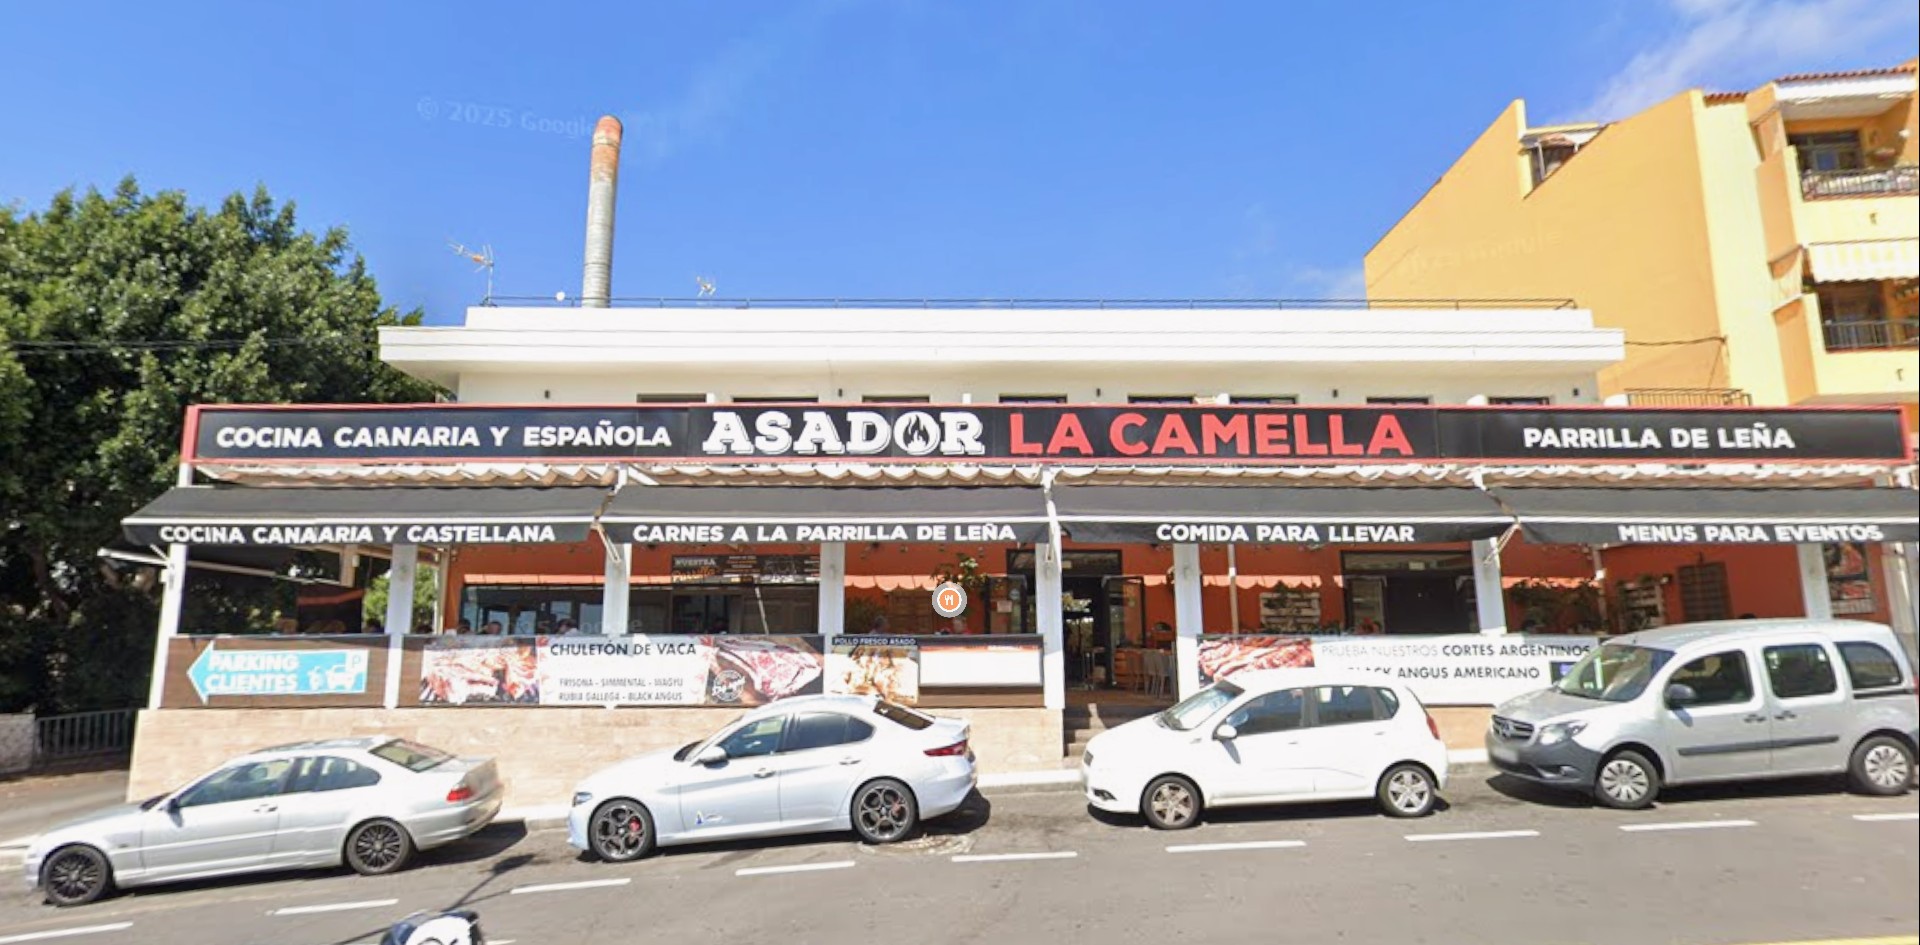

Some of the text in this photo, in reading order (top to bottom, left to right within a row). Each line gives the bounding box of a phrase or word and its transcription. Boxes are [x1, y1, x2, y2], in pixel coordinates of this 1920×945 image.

[216, 426, 323, 449] COCINA
[489, 426, 510, 447] Y
[523, 419, 673, 448] ESPAÑOLA
[702, 411, 1415, 455] ASADOR LA CAMELLA
[1524, 421, 1796, 449] PARRILLA DE LEÑA
[159, 526, 246, 543] COCINA
[382, 526, 399, 542] Y
[406, 525, 555, 543] CASTELLANA
[632, 523, 1017, 542] CARNES A LA PARRILLA DE LEÑA
[1156, 524, 1415, 542] COMIDA PARA LLEVAR
[1617, 524, 1884, 542] MENUS PARA EVENTOS
[550, 640, 697, 656] CHULETÓN DE VACA
[834, 637, 916, 646] POLLO FRESCO ASADO
[1321, 645, 1368, 657] PRUEBA
[1371, 645, 1438, 657] NUESTROS
[1442, 645, 1495, 657] CORTES
[207, 653, 299, 673] PARKING
[1397, 667, 1449, 679] ANGUS
[1453, 667, 1541, 679] AMERICANO
[205, 674, 298, 692] CLIENTES
[559, 691, 583, 701] RUBIA
[628, 691, 652, 701] BLACK
[654, 691, 684, 701] ANGUS
